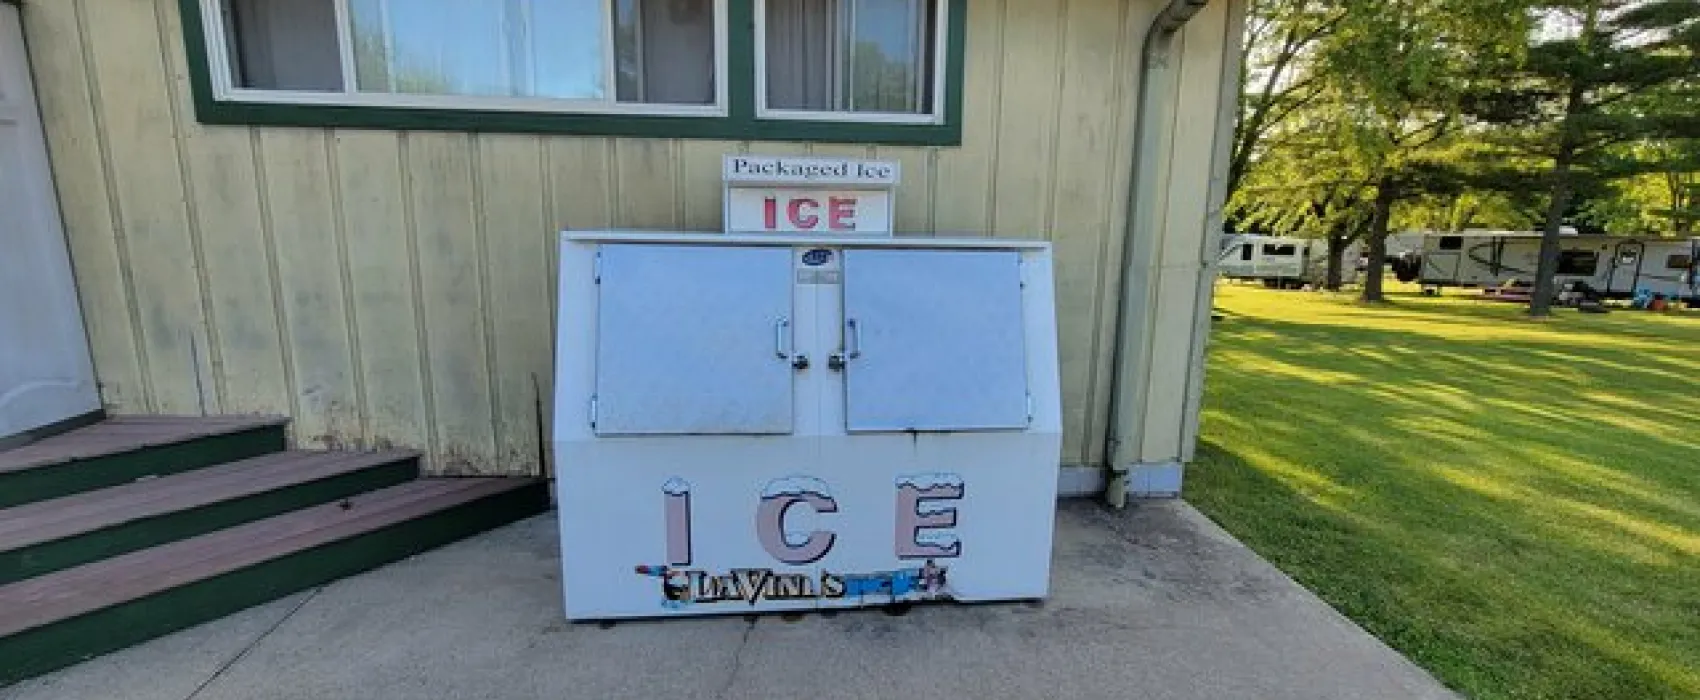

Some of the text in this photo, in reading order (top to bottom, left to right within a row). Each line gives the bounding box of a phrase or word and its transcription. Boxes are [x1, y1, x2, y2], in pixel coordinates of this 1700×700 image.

[733, 158, 891, 179] Packaged Ice
[763, 196, 858, 230] ICE
[661, 473, 965, 567] ICE
